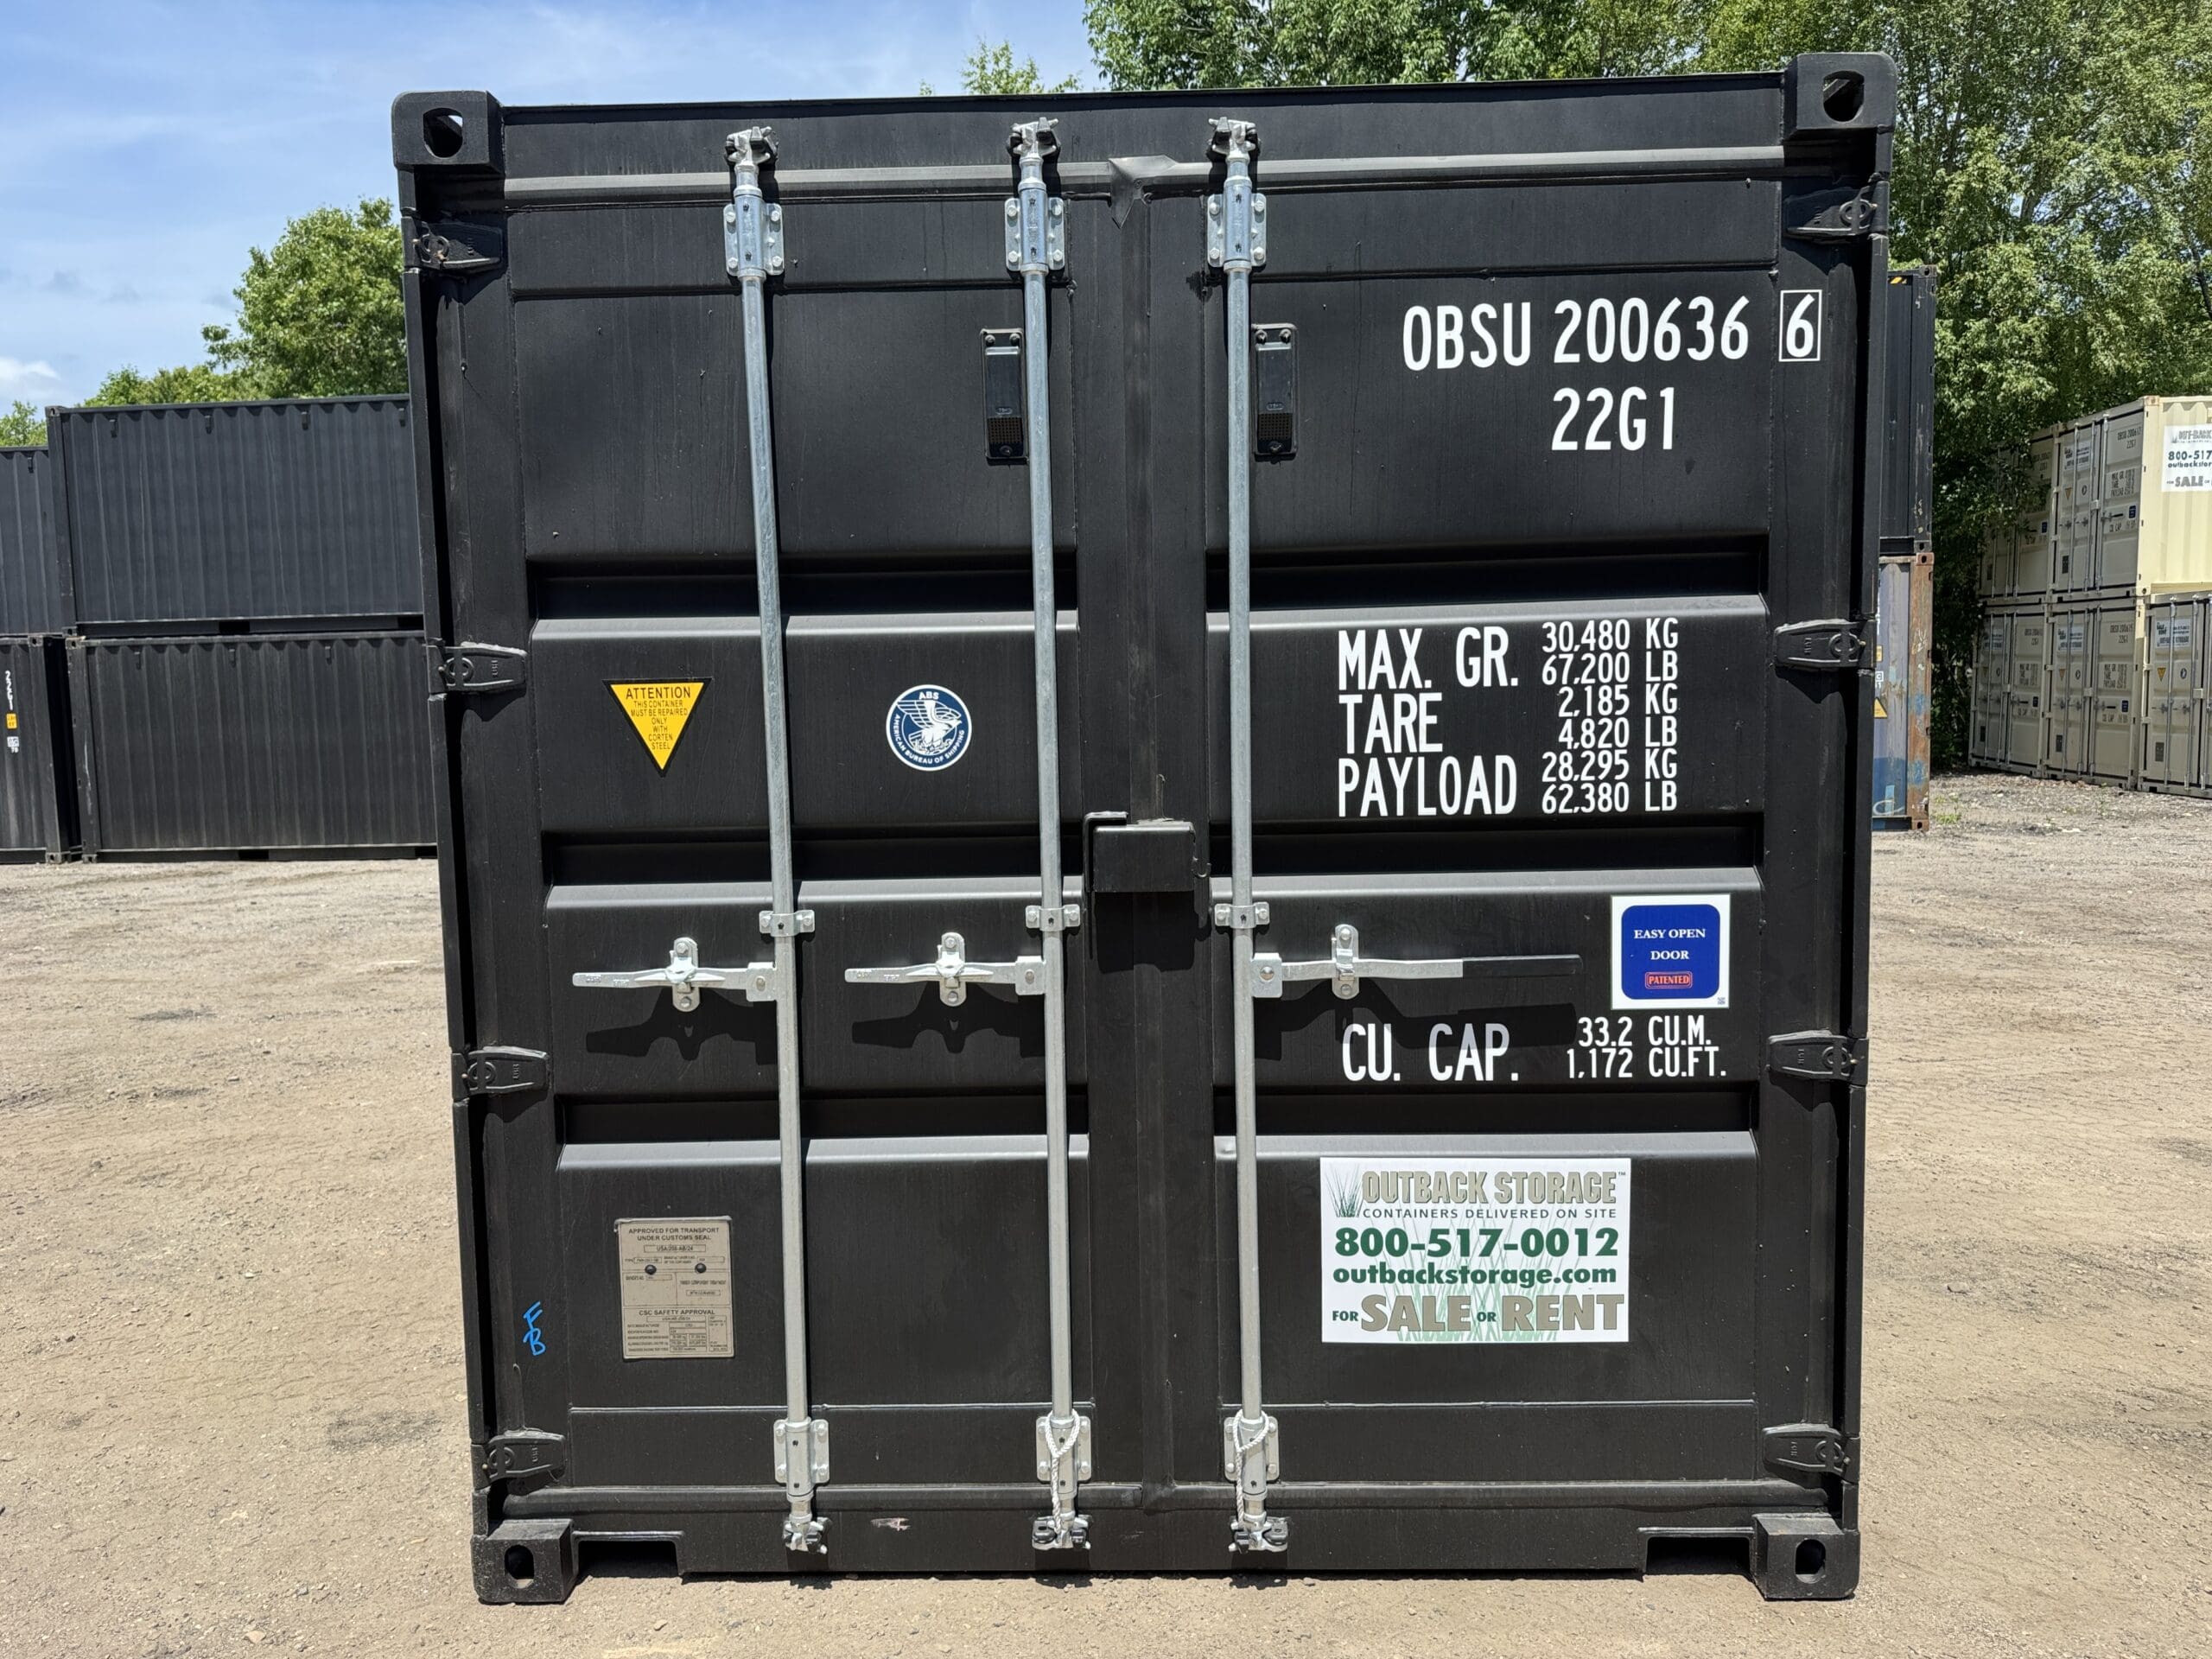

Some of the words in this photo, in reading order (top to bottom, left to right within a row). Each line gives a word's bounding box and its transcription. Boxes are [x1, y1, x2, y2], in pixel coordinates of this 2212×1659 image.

[1403, 302, 1531, 371] OBSU
[1554, 296, 1750, 363] 200636
[1786, 294, 1815, 358] 6
[1552, 386, 1675, 450] 22G1
[2175, 476, 2203, 486] SALE
[1338, 628, 1432, 690] MAX.
[1456, 626, 1518, 687] GR.
[1541, 619, 1630, 652] 30,480
[1646, 618, 1678, 650] KG
[1541, 652, 1630, 685] 67,200
[1646, 651, 1677, 682] LB
[626, 687, 690, 699] ATTENTION
[918, 691, 939, 700] ABS
[1338, 692, 1443, 753] TARE
[1558, 684, 1630, 717] 2,185
[1646, 683, 1677, 715] KG
[1558, 718, 1630, 750] 4,820
[1645, 715, 1677, 747] LB
[893, 714, 906, 752] AMERICAN
[905, 750, 933, 765] BUREAU
[944, 729, 965, 759] SHIPPING
[1338, 754, 1517, 817] PAYLOAD
[1541, 749, 1630, 782] 28,295
[1645, 748, 1677, 779] KG
[1541, 782, 1630, 814] 62,380
[1645, 780, 1677, 811] LB
[1634, 929, 1666, 939] EASY
[1669, 928, 1706, 938] OPEN
[1650, 950, 1689, 960] DOOR
[1649, 976, 1690, 984] PATENTED
[1343, 1023, 1401, 1082] CU.
[1428, 1023, 1518, 1082] CAP.
[1578, 1017, 1633, 1048] 33.2
[1648, 1015, 1711, 1046] CU.M.
[1567, 1048, 1633, 1079] 1,172
[1649, 1046, 1726, 1077] CU.FT.
[1361, 1171, 1489, 1204] OUTBACK
[1494, 1171, 1618, 1204] STORAGE
[1363, 1209, 1459, 1218] CONTAINERS
[1466, 1209, 1549, 1218] DELIVERED
[1556, 1209, 1577, 1218] ON
[1585, 1209, 1617, 1218] SITE
[1335, 1227, 1618, 1257] 800-517-0012
[1333, 1262, 1617, 1288] outbackstorage.com
[1332, 1311, 1358, 1322] FOR
[1361, 1294, 1471, 1332] SALE
[1477, 1312, 1497, 1322] OR
[1502, 1294, 1624, 1331] RENT
